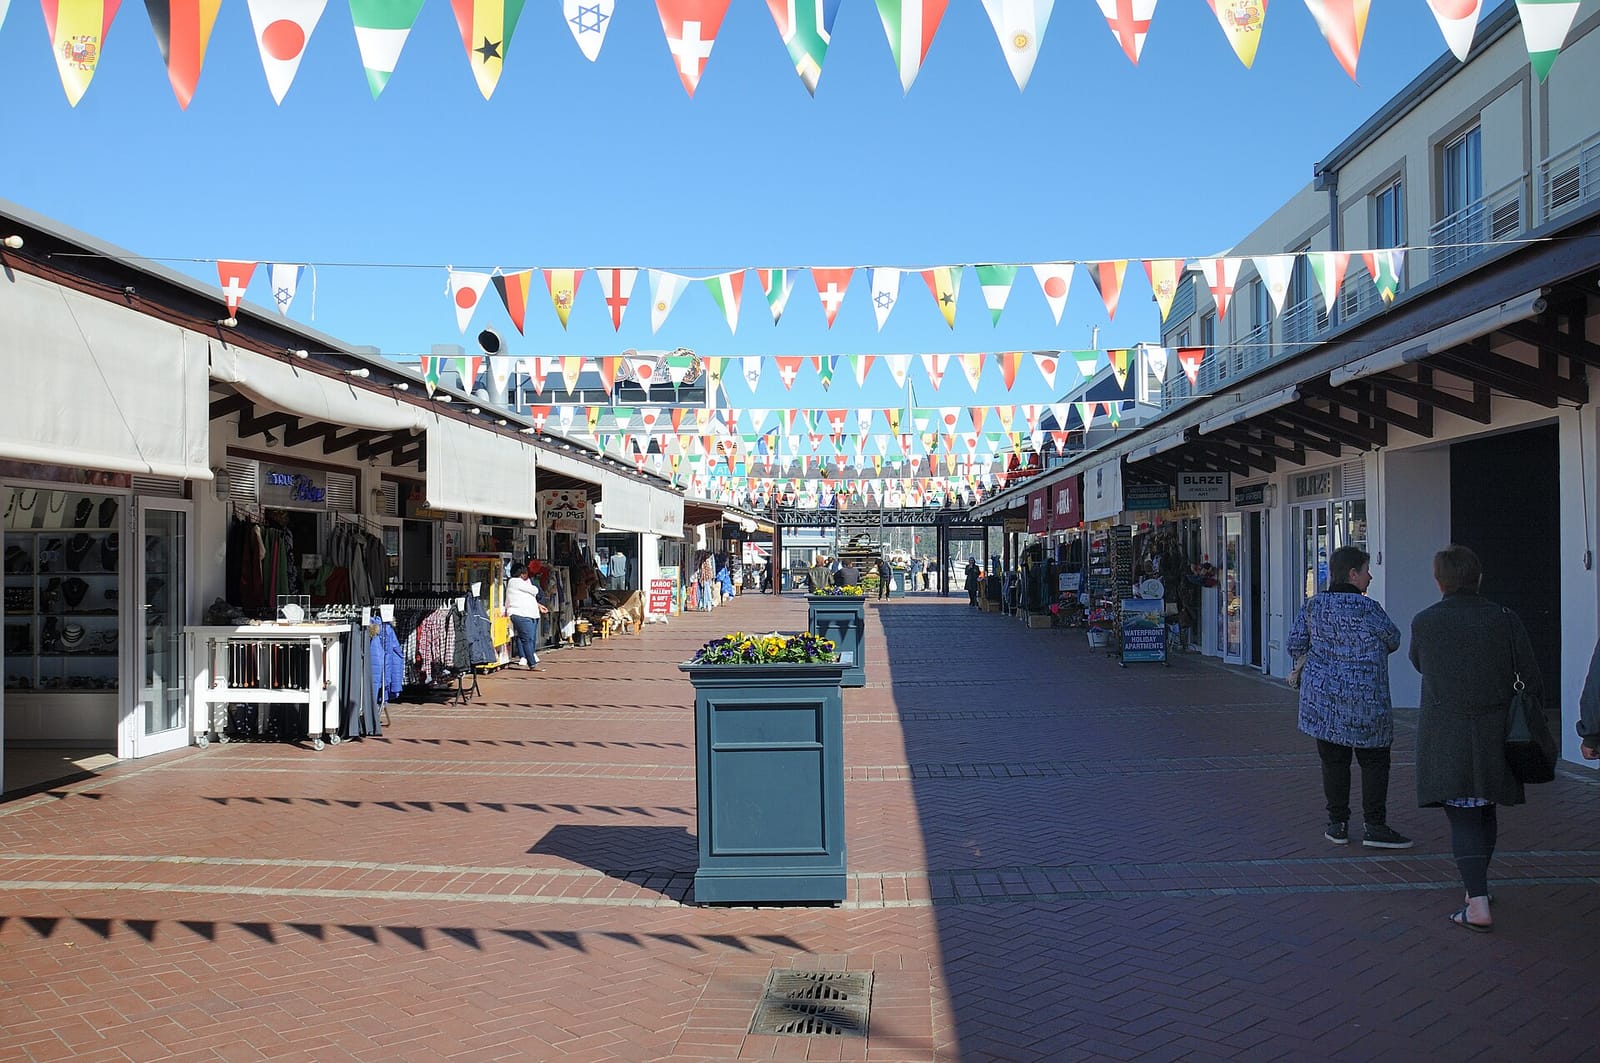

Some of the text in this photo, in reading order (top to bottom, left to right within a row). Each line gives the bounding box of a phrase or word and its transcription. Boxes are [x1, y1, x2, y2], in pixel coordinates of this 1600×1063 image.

[271, 472, 295, 486] TRUE
[1183, 475, 1223, 485] BLAZE
[566, 510, 585, 519] DOGS
